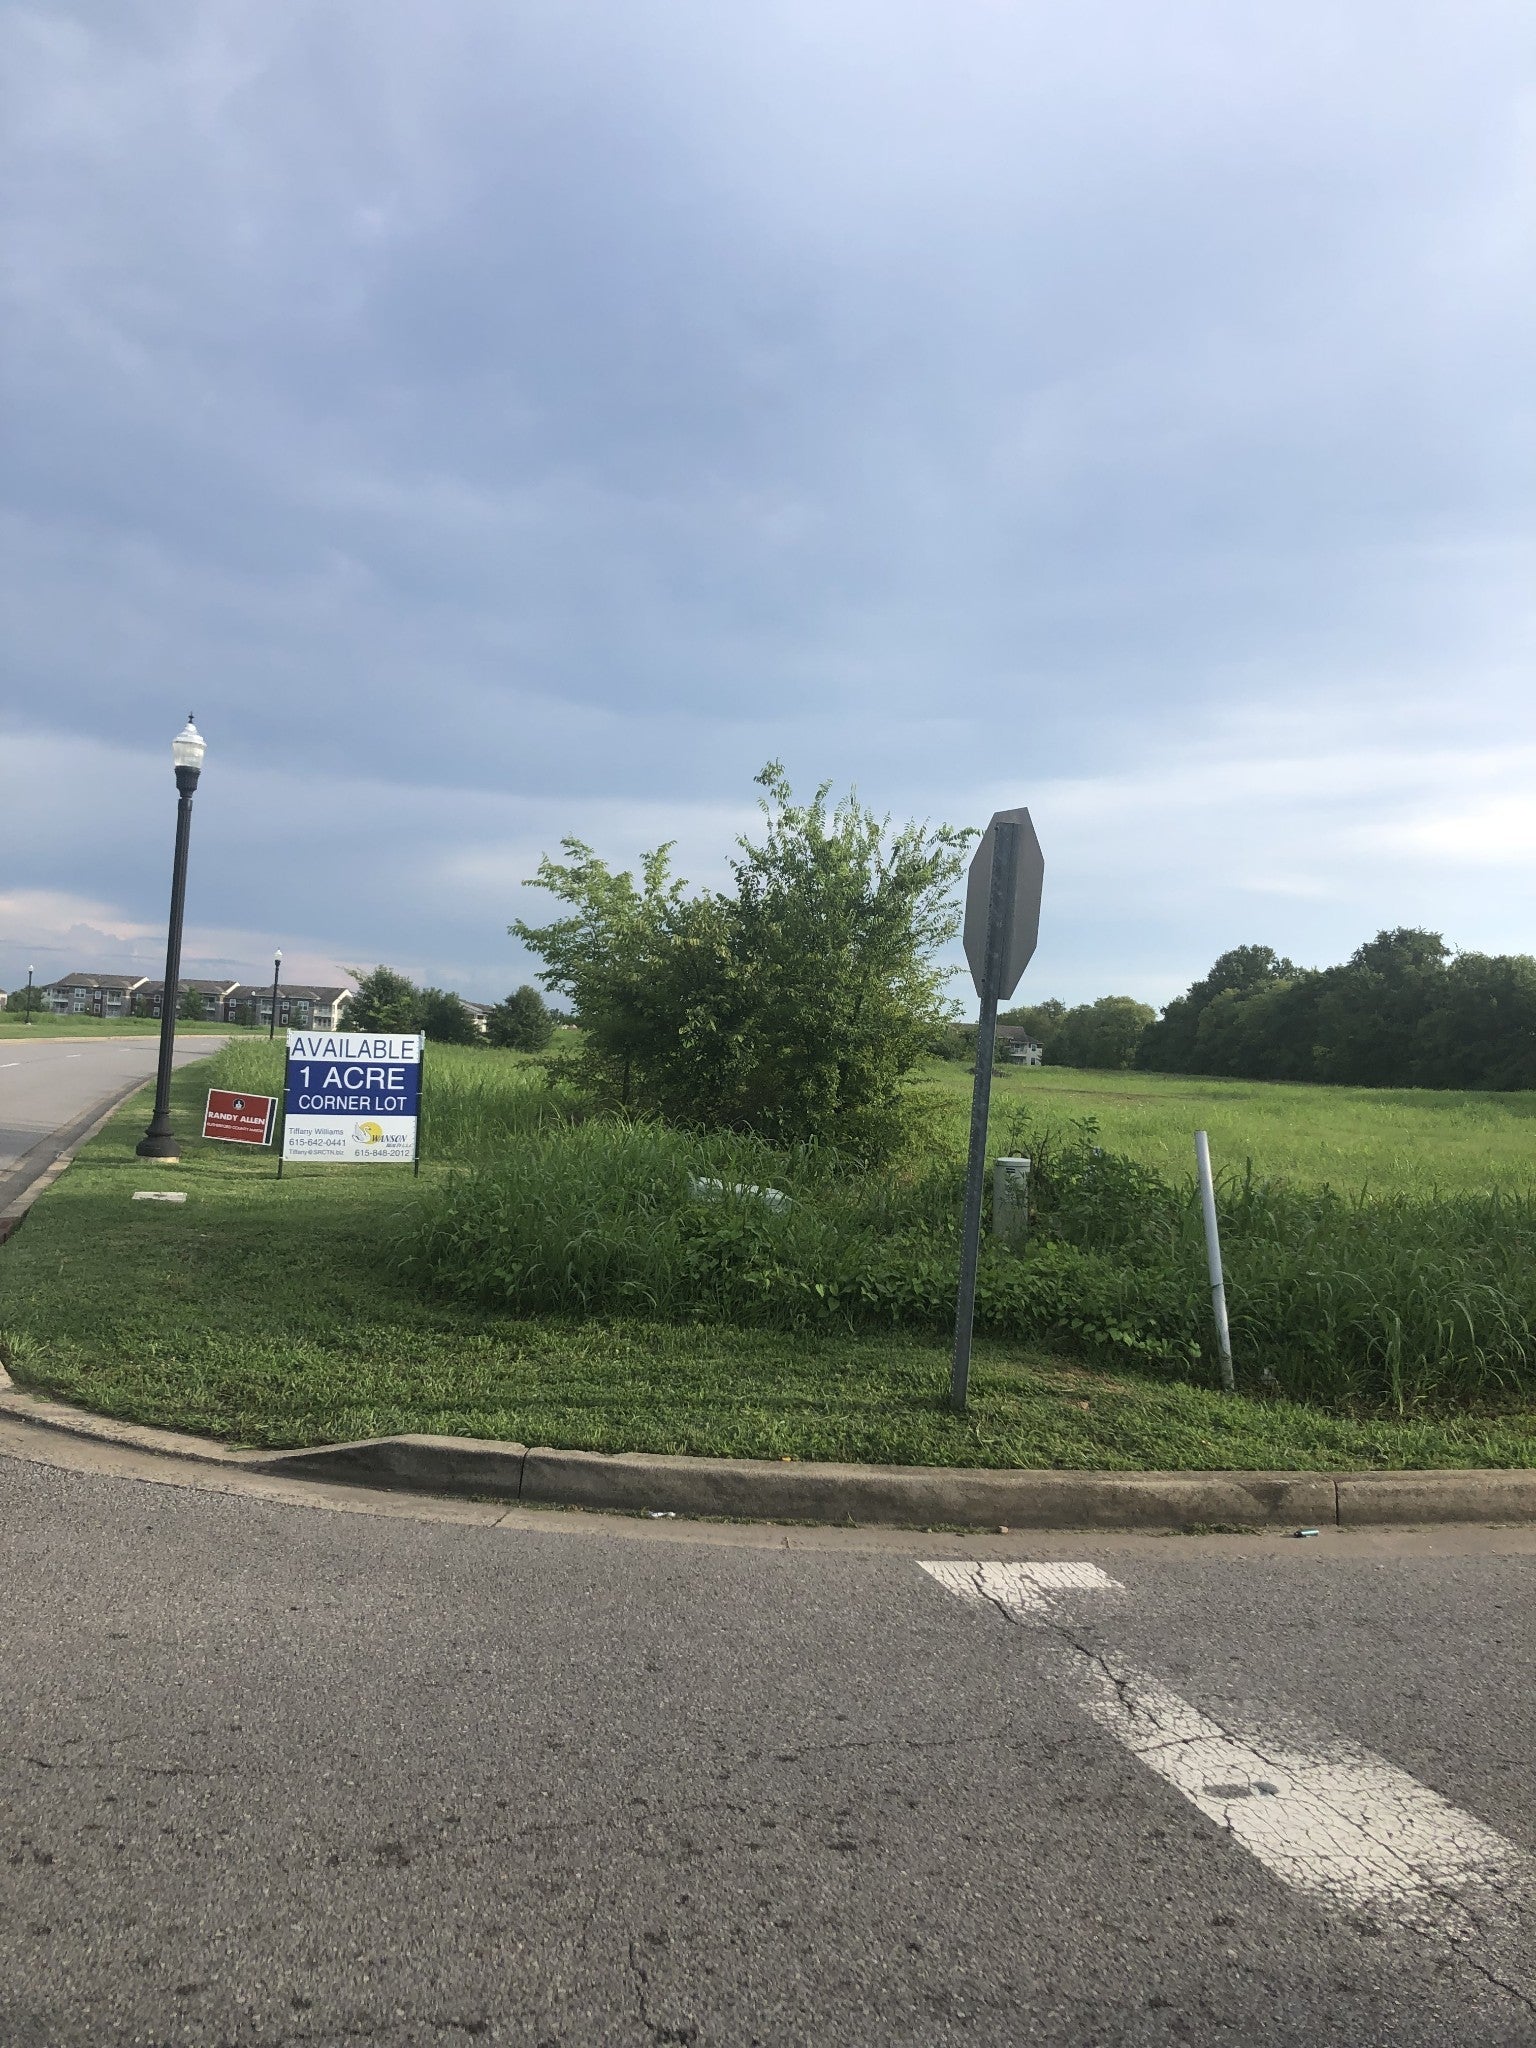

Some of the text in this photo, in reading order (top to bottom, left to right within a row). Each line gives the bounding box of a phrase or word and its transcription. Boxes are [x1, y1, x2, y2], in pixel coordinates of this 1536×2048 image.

[291, 1037, 415, 1059] AVAILABLE
[300, 1066, 406, 1090] 1 ACRE
[298, 1094, 407, 1111] CORNER LOT
[208, 1111, 266, 1125] RANDY ALLEN
[289, 1127, 344, 1136] Tiffany Williams
[289, 1138, 346, 1147] 615-642-0441
[354, 1149, 410, 1157] 615-848-2012
